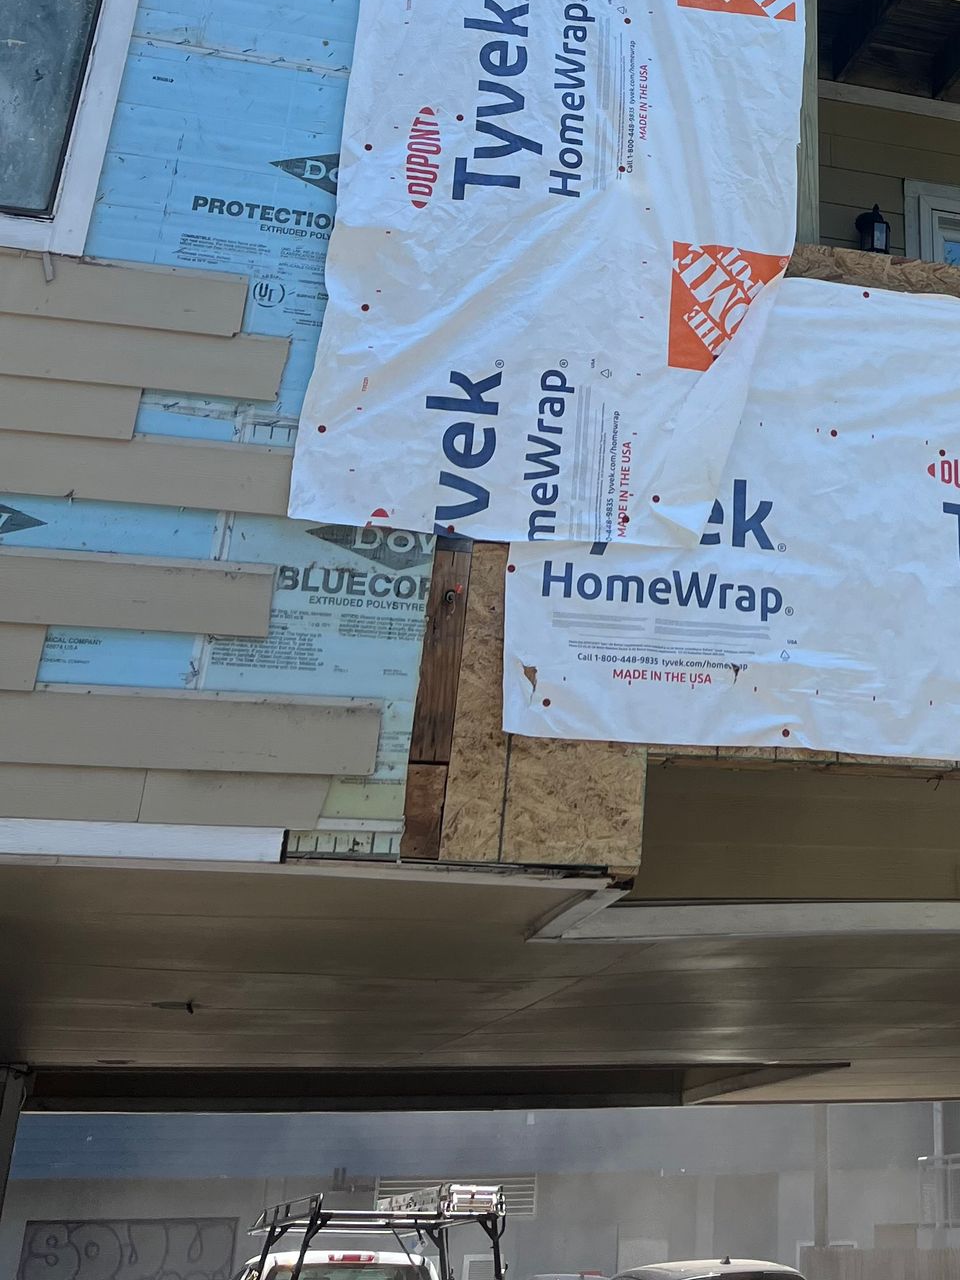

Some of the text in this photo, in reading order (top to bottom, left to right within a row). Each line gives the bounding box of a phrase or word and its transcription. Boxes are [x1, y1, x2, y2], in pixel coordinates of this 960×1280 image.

[548, 2, 595, 198] HomeWrap
[639, 64, 648, 141] MADE IN THE USA
[406, 117, 442, 197] DUPONT
[191, 194, 336, 231] PROTECTIO
[260, 223, 308, 237] EXTRUDED
[426, 370, 504, 530] vek
[523, 369, 575, 542] meWrap
[608, 410, 620, 495] tyvek.com/homewrap
[617, 441, 632, 538] MADE IN THE USA
[309, 595, 424, 612] EXTRUDED POLYSTYRE
[541, 560, 783, 622] HomeWrap
[577, 652, 593, 662] Call
[594, 653, 659, 666] 1-800-448-9835
[612, 668, 712, 685] MADE IN THE USA
